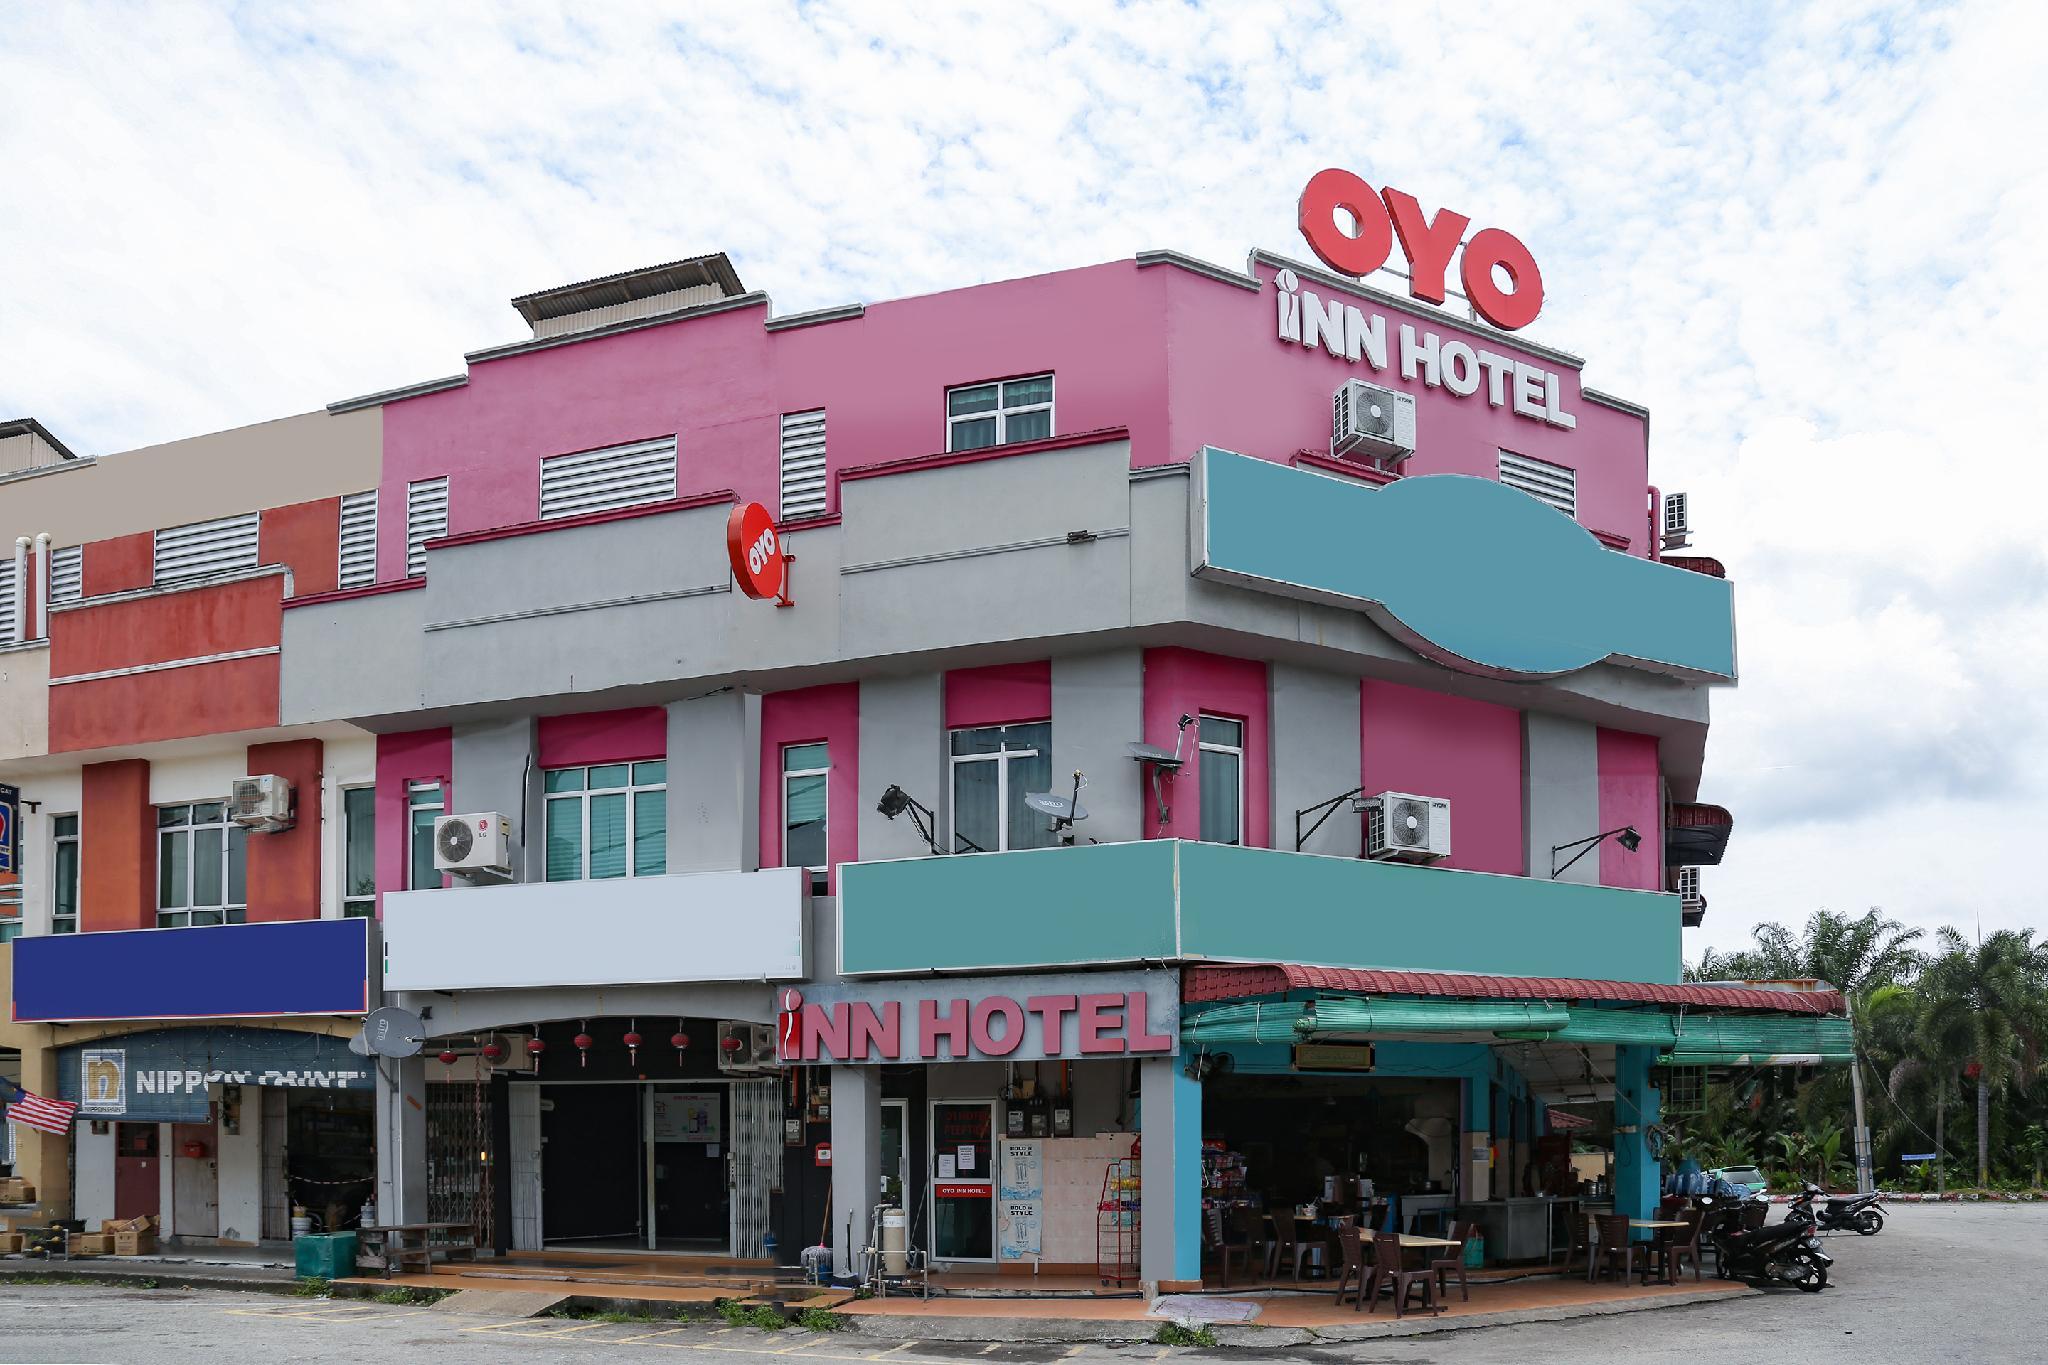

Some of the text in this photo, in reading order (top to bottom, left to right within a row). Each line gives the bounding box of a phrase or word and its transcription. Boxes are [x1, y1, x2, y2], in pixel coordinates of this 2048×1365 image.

[1298, 168, 1544, 331] OYO
[1400, 323, 1577, 429] HOTEL
[749, 528, 776, 575] OYO
[919, 991, 1172, 1057] HOTEL
